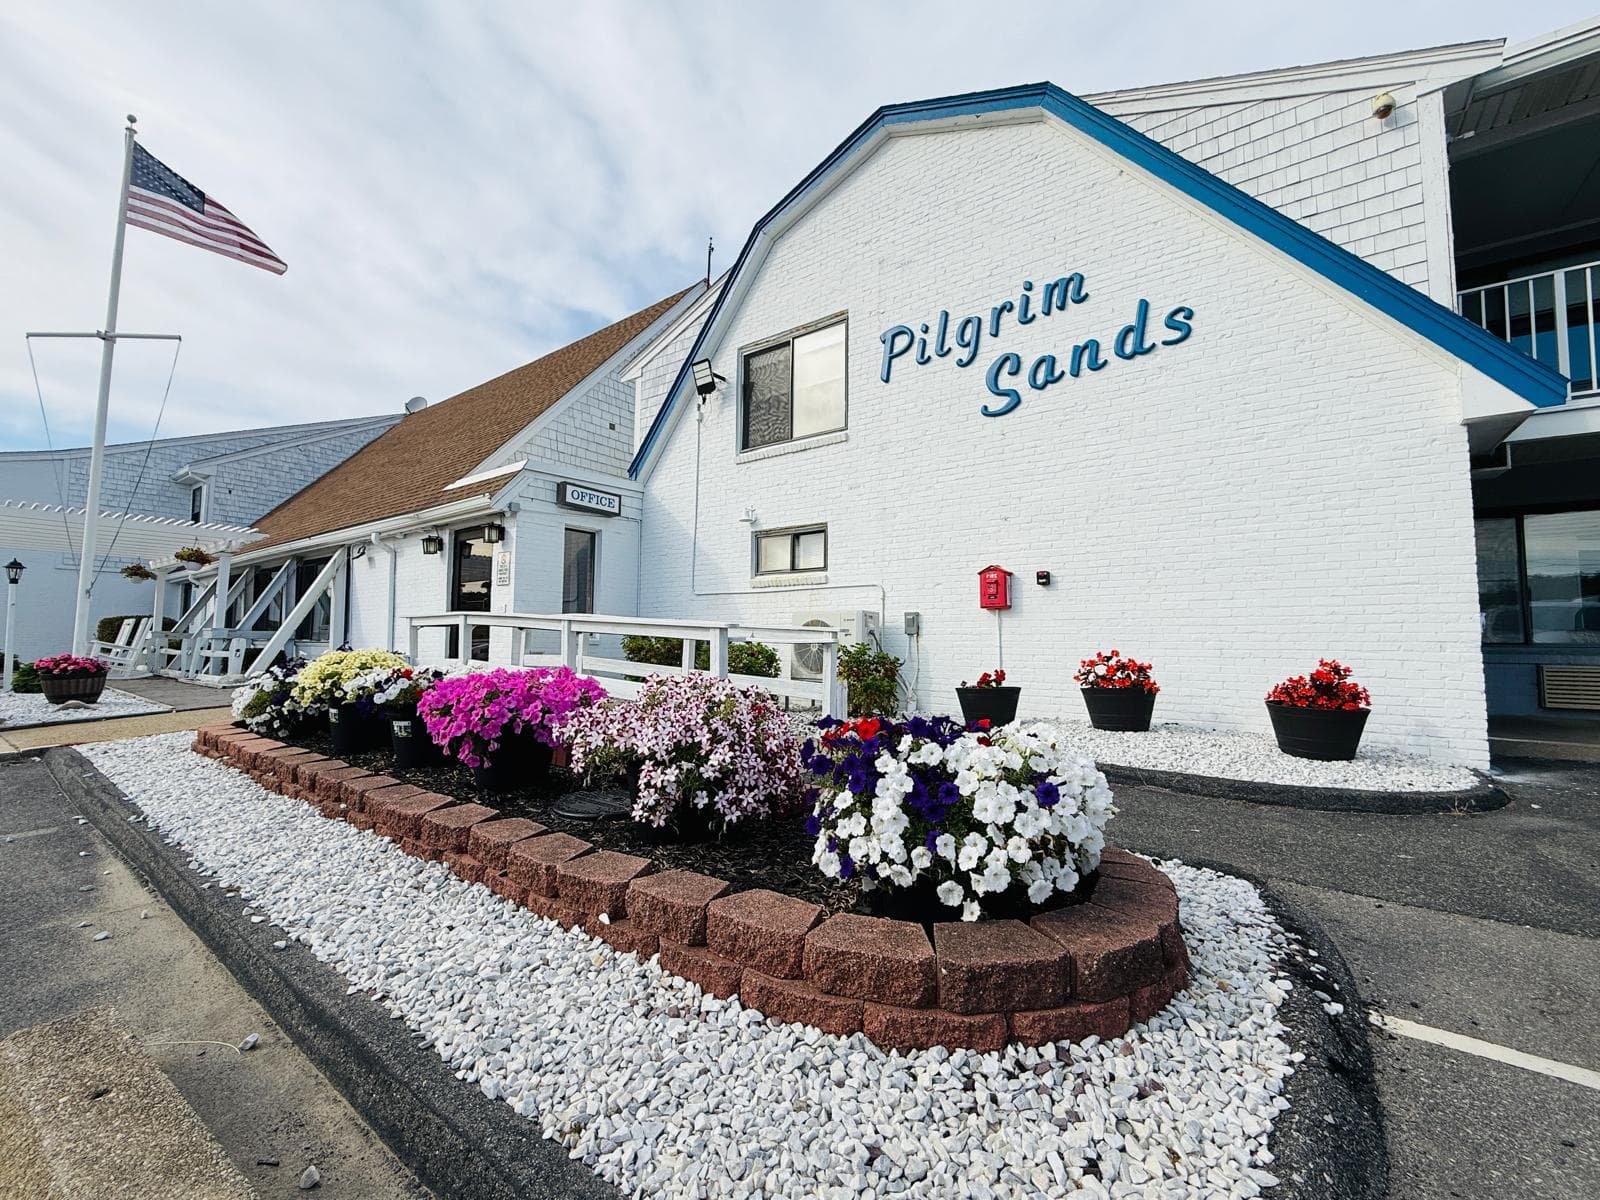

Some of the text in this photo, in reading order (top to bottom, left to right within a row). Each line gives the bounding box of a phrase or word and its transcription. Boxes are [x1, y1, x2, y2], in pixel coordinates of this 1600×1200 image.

[880, 272, 1089, 384] Pilgrim
[980, 298, 1194, 418] Sands
[571, 489, 615, 508] OFFICE
